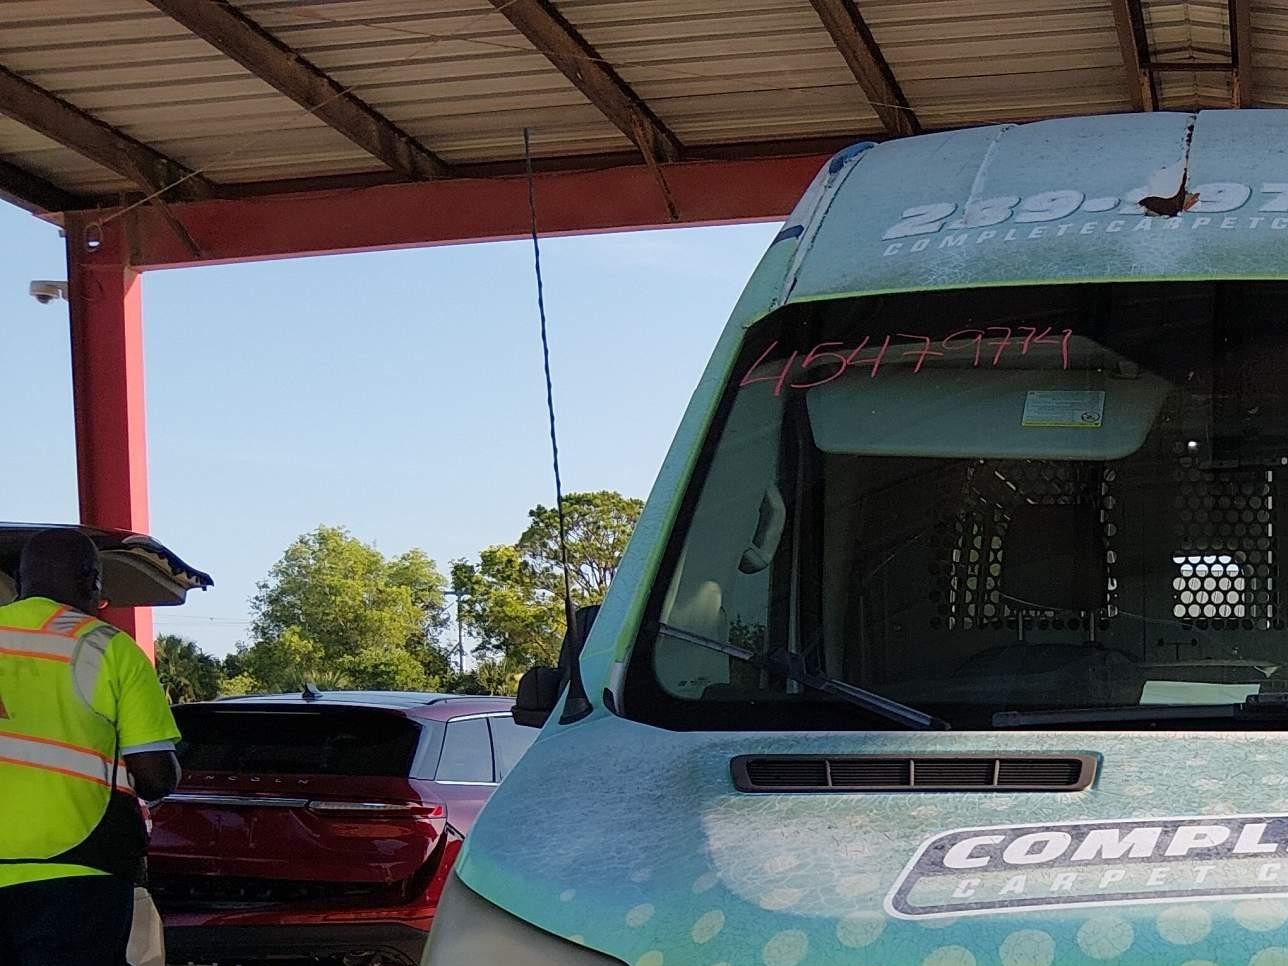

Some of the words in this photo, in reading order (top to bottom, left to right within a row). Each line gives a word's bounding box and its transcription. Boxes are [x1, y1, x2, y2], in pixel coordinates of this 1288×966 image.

[739, 326, 1072, 396] 45479774
[188, 774, 309, 785] INCOLN
[952, 865, 1216, 899] CARPET
